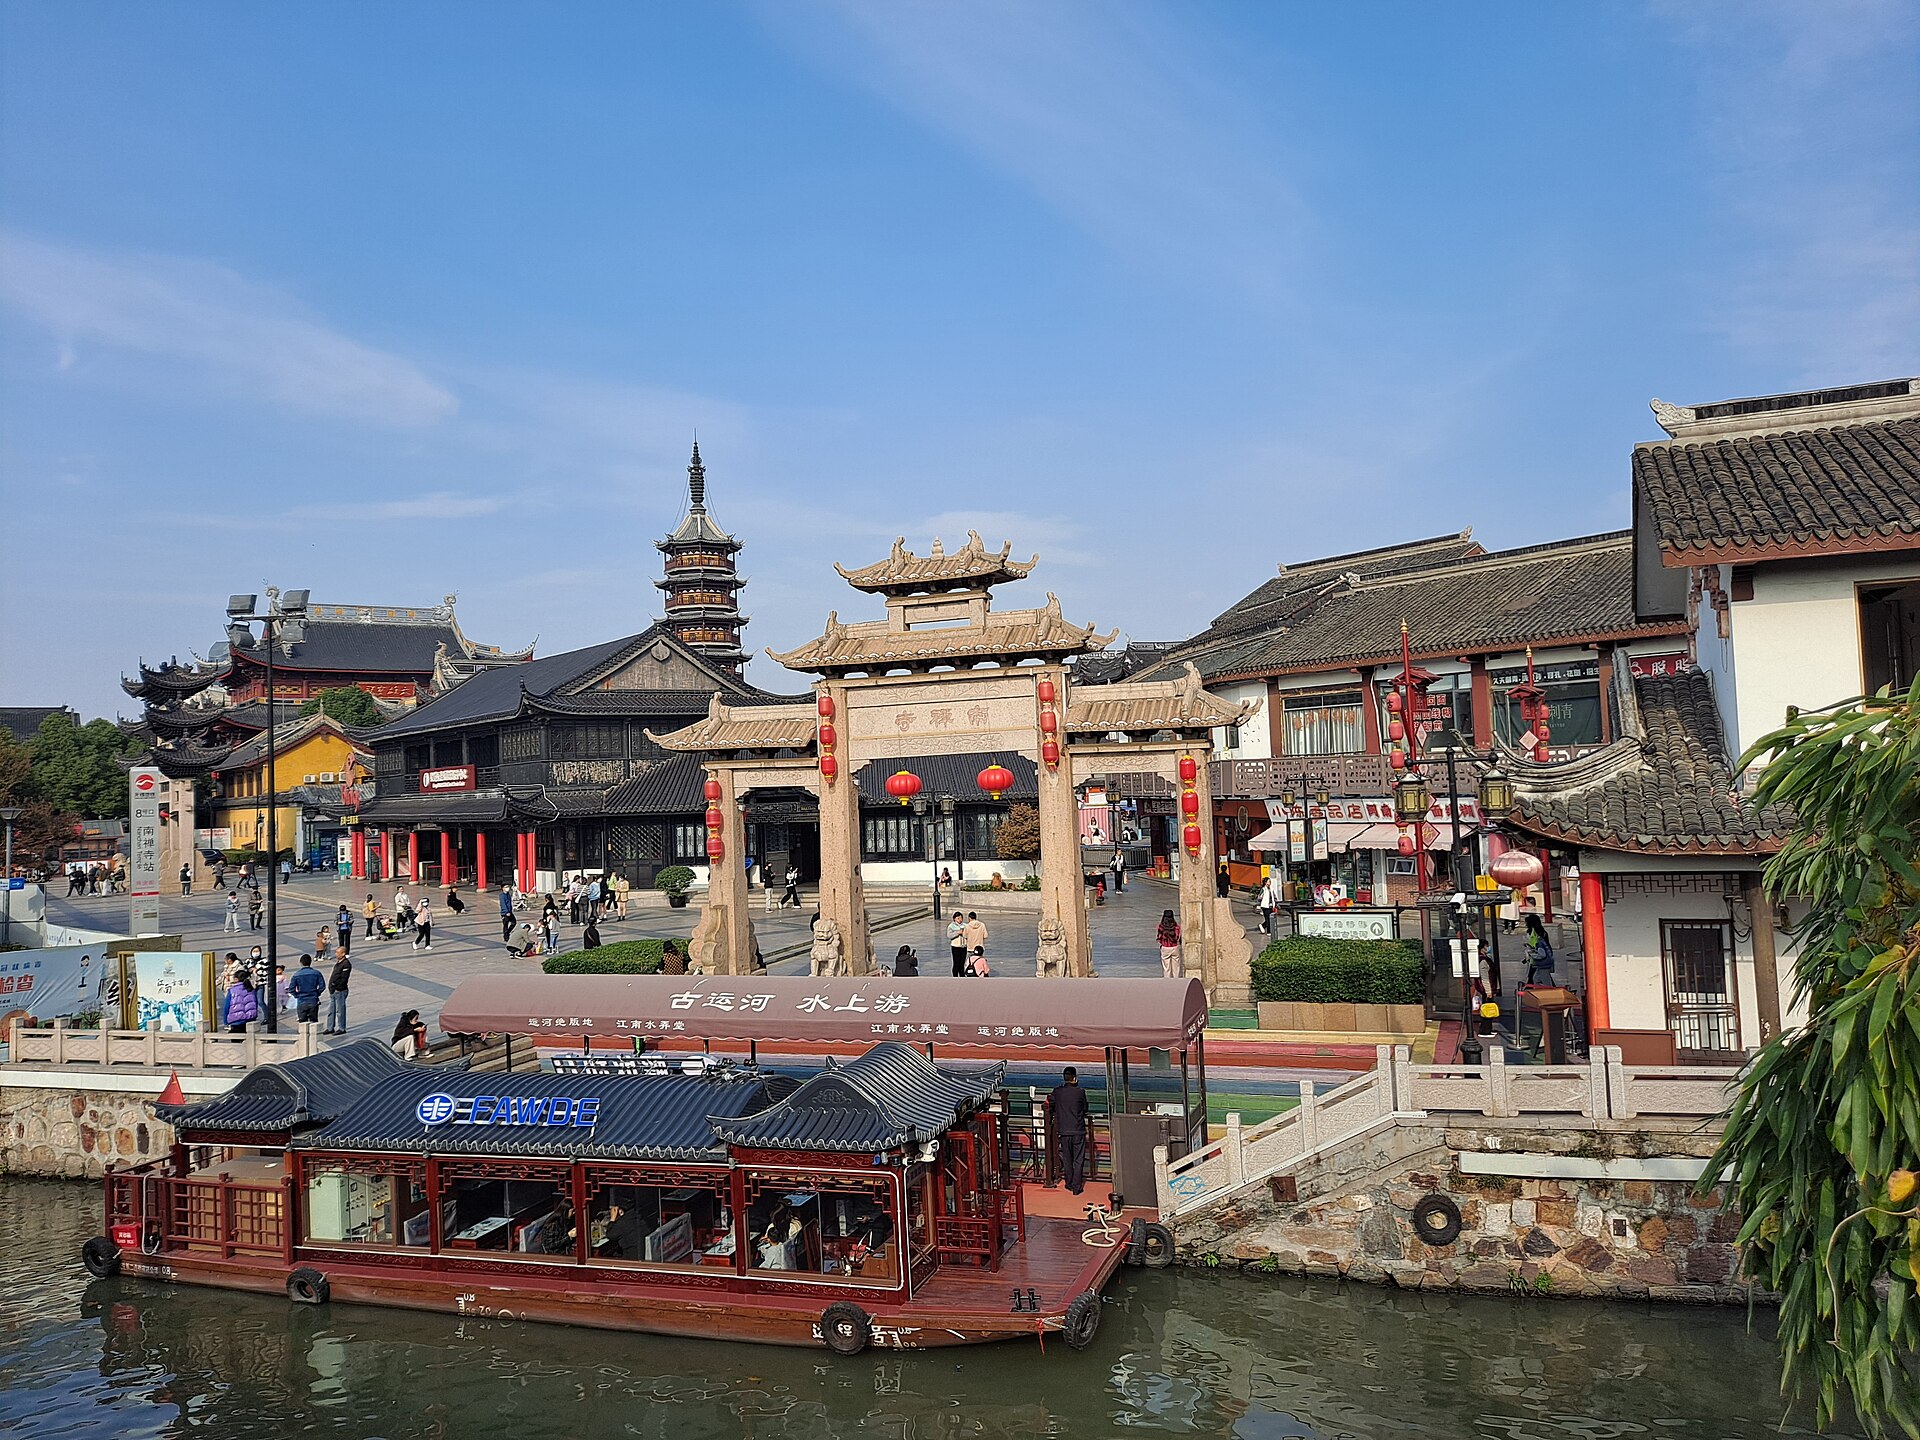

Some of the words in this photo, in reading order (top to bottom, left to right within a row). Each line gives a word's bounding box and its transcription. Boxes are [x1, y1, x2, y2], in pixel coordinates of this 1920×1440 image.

[143, 826, 155, 872] 南禅寺站
[669, 991, 776, 1012] 古运河
[795, 992, 911, 1013] 水上游
[528, 1017, 594, 1028] 运河绝版地
[616, 1019, 686, 1030] 江南水弄堂
[870, 1023, 949, 1035] 江南水弄堂
[977, 1026, 1059, 1037] 运河绝版地
[469, 1096, 600, 1127] FAWDE
